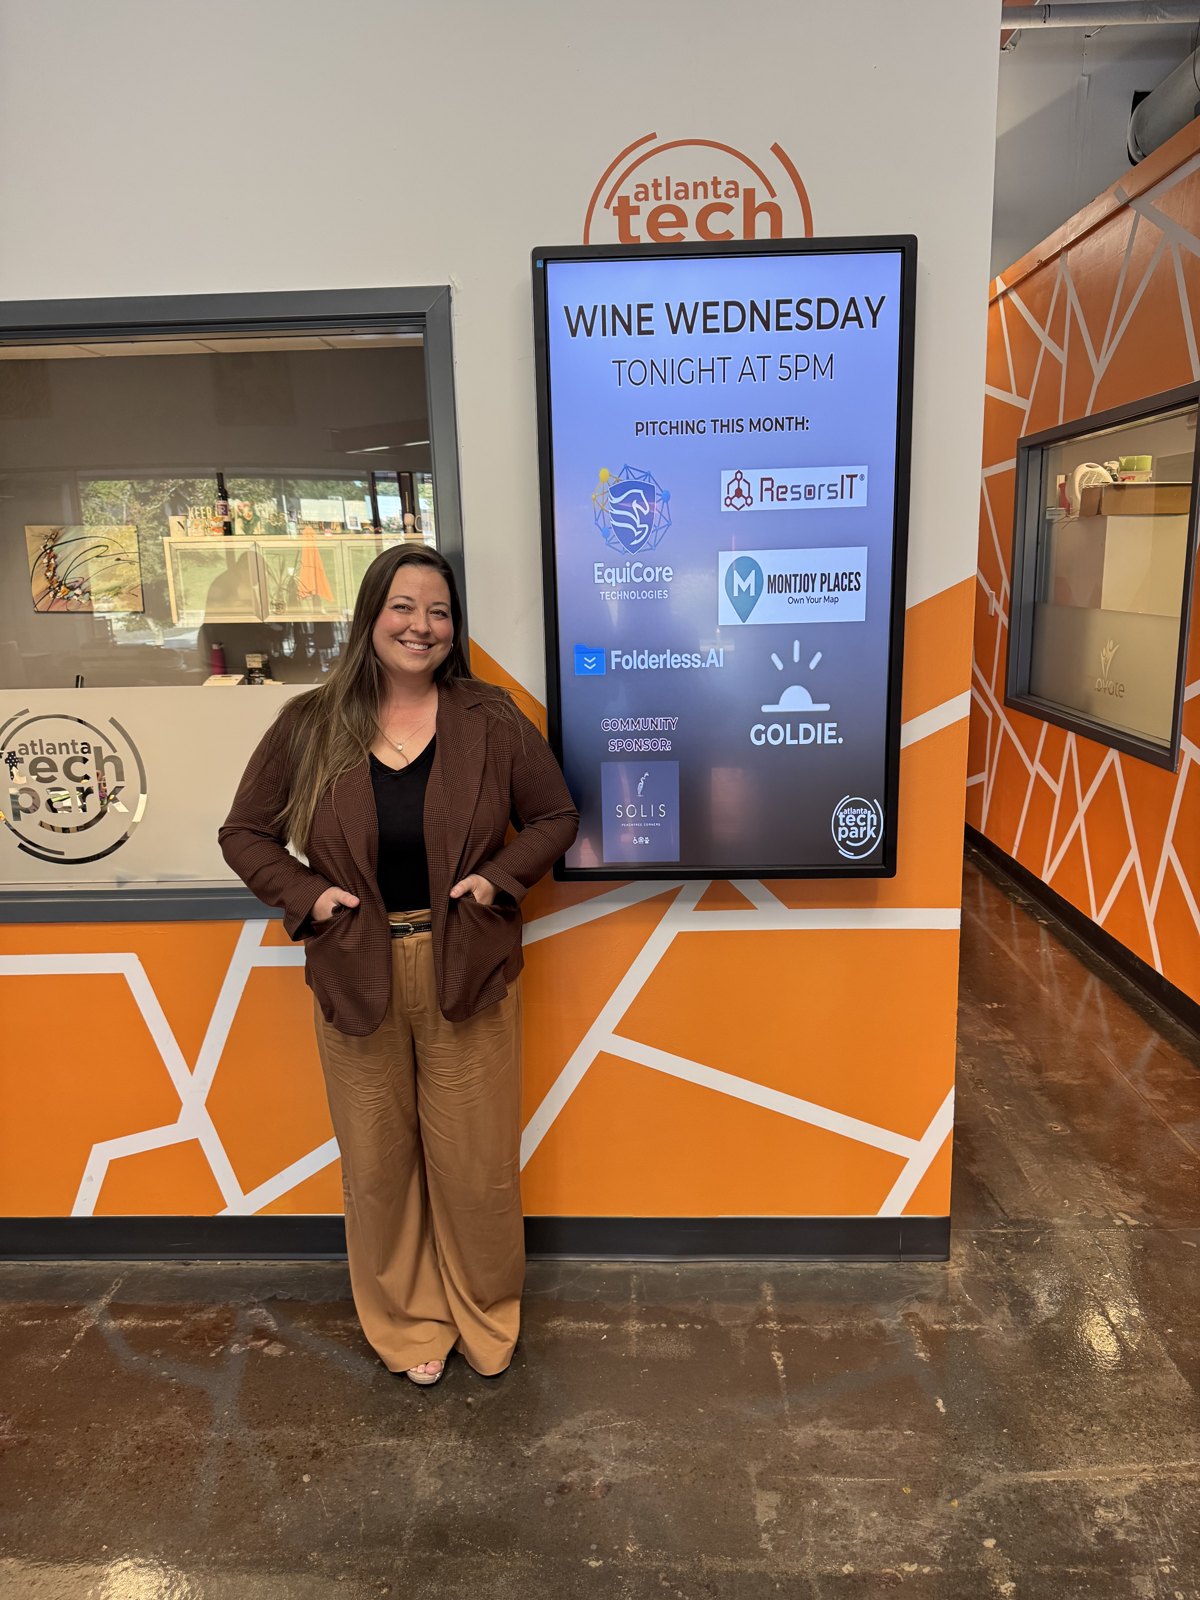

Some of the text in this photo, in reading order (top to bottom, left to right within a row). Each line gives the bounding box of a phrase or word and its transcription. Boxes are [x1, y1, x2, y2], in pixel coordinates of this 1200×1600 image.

[633, 176, 740, 202] atlanta
[612, 187, 783, 244] tech
[563, 295, 886, 338] WINE WEDNESDAY
[611, 353, 834, 387] TONIGHT AT 5PM
[635, 416, 810, 437] PITCHING THIS MONTH:
[593, 561, 674, 587] EquiCore
[733, 569, 756, 597] M
[767, 571, 862, 595] MONTJOY PLACES
[599, 589, 669, 601] TECHNOLOGIES
[787, 595, 840, 605] Own Your Map
[610, 648, 724, 670] Folderless.AI
[600, 716, 679, 732] COMMUNITY
[749, 722, 843, 746] GOLDIE.
[18, 738, 92, 756] atlanta
[608, 738, 672, 752] SPONSOR:
[4, 746, 126, 784] tech
[7, 782, 130, 822] park
[615, 803, 667, 819] SOLIS
[843, 806, 868, 815] atlanta
[838, 810, 878, 827] tech
[837, 825, 877, 842] park
